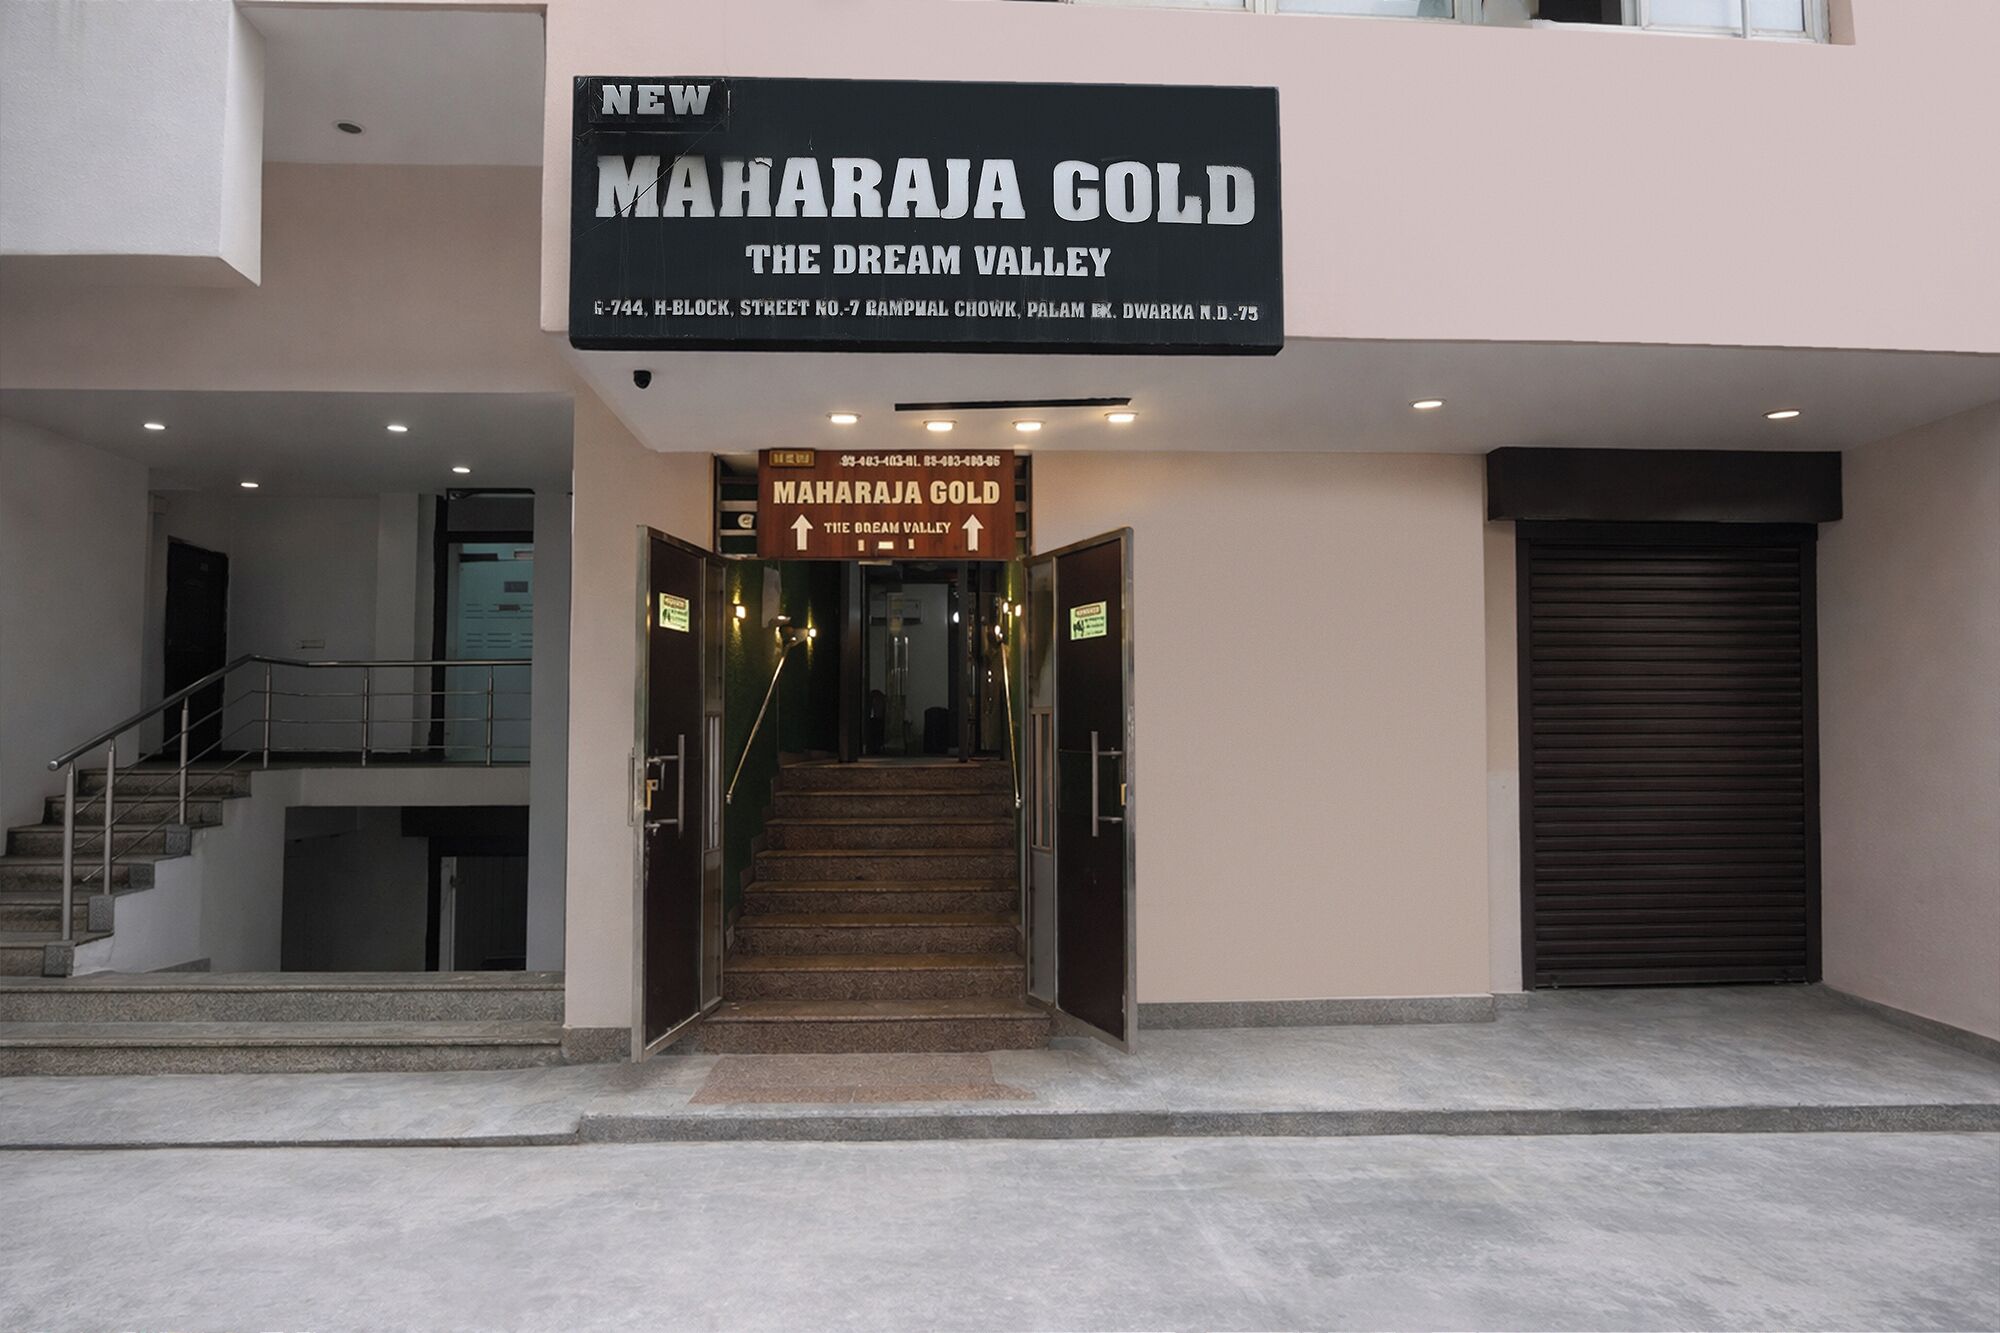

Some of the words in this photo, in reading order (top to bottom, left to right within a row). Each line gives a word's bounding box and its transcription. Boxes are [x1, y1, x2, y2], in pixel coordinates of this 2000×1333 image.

[602, 84, 711, 115] NEW
[596, 155, 1025, 219] MAHARAJA
[1054, 160, 1255, 225] GOLD
[746, 245, 820, 274] THE
[833, 245, 960, 274] DREAM
[974, 246, 1111, 276] VALLEY
[655, 300, 734, 317] H-BLOCK,
[741, 299, 810, 315] STREET
[816, 300, 859, 316] NO.-7
[955, 300, 1021, 319] CHOWK,
[1028, 302, 1084, 317] PALAM
[1123, 303, 1194, 319] DWARKA
[774, 481, 922, 504] MAHARAJA
[930, 481, 999, 504] GOLD
[824, 522, 850, 533] THE
[855, 522, 899, 533] DREAM
[903, 522, 951, 533] VALLEY
